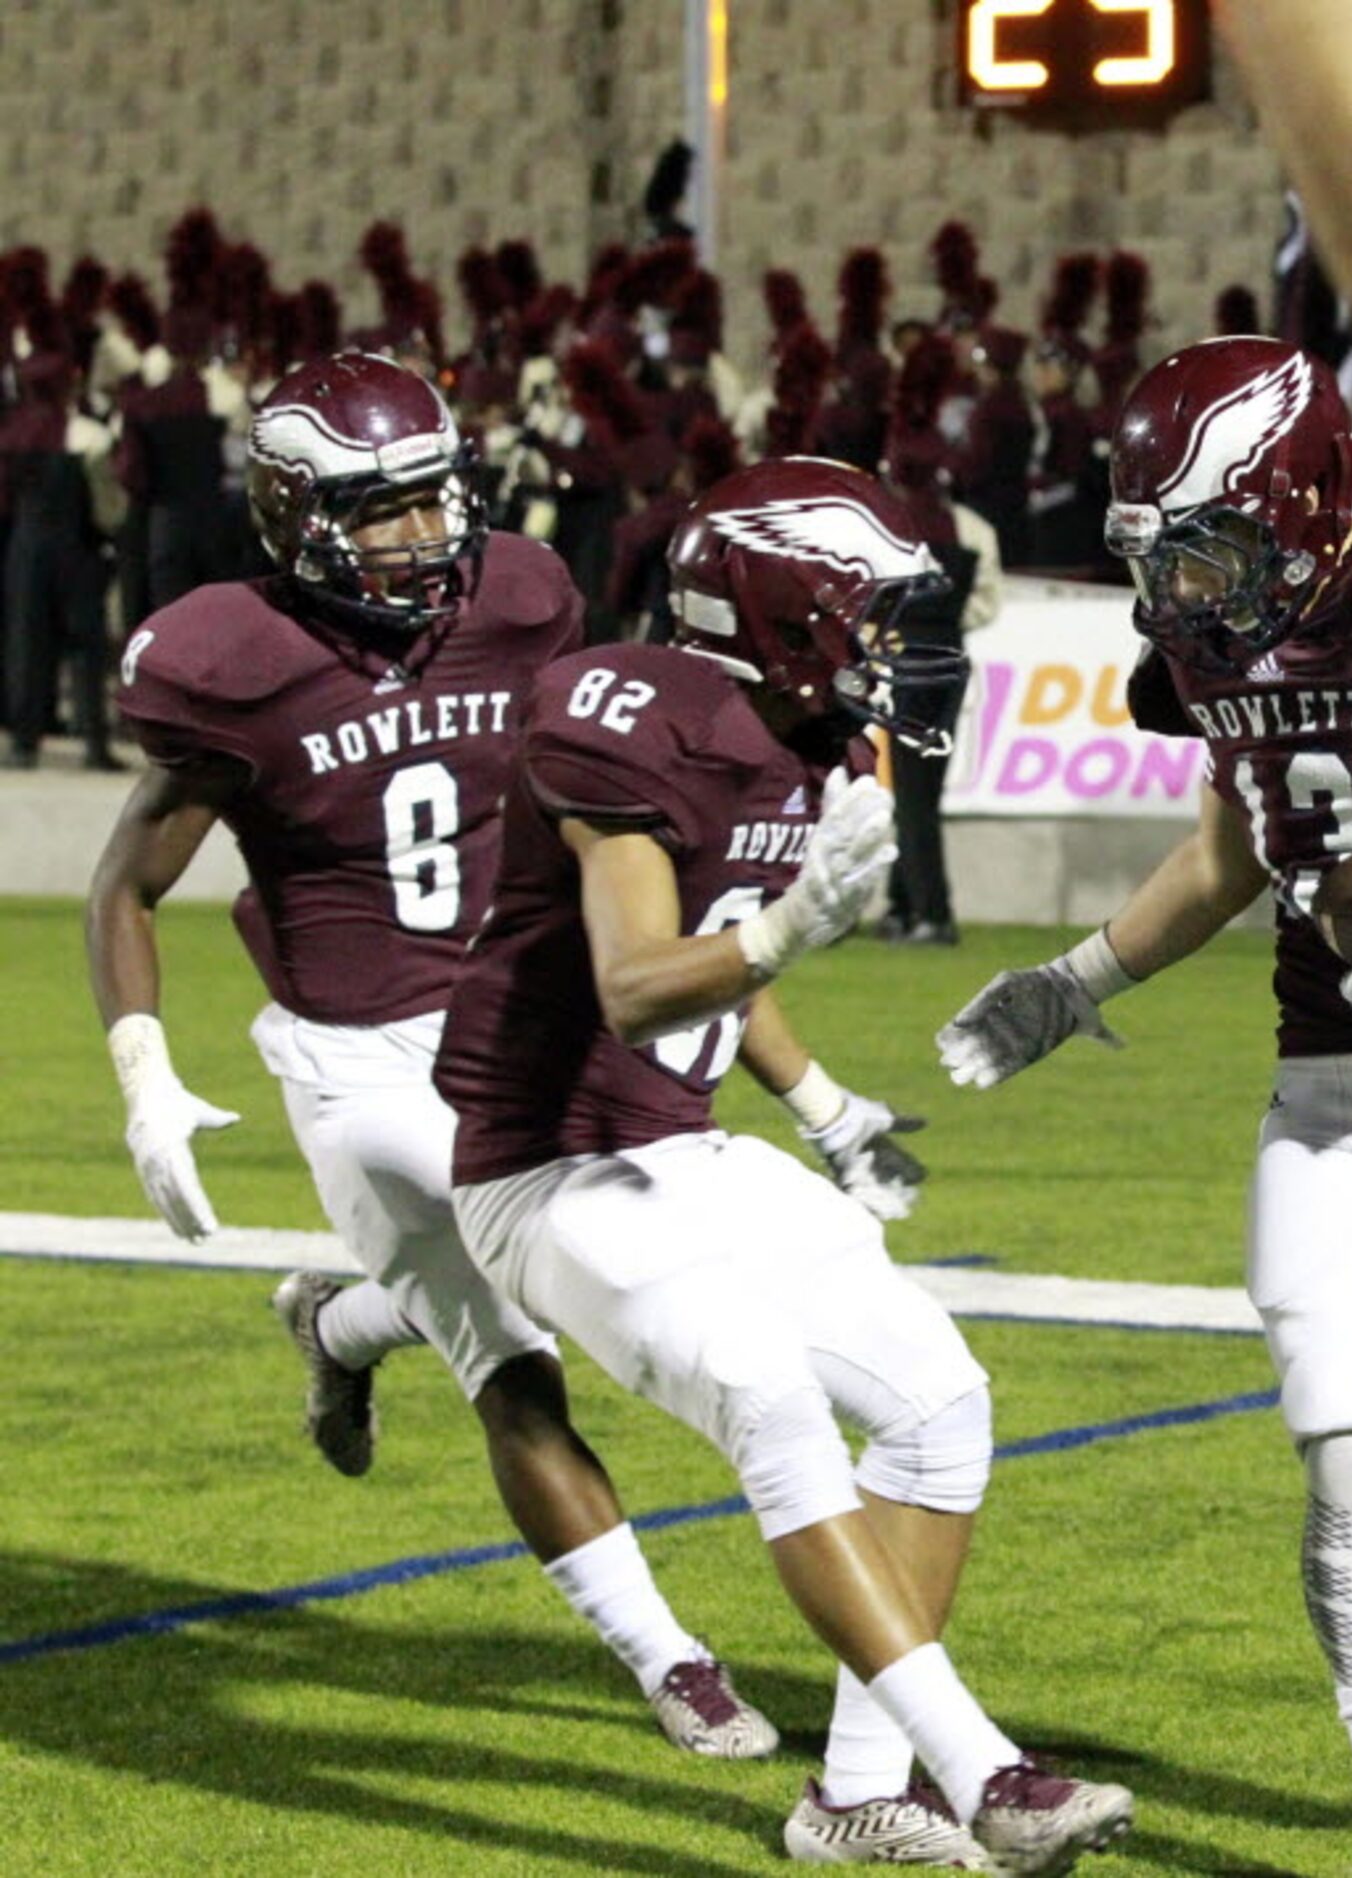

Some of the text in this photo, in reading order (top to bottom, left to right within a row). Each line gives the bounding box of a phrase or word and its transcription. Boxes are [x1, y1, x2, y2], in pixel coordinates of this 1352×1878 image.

[301, 692, 511, 774] ROWLETT
[566, 667, 657, 735] 82
[383, 762, 460, 931] 8
